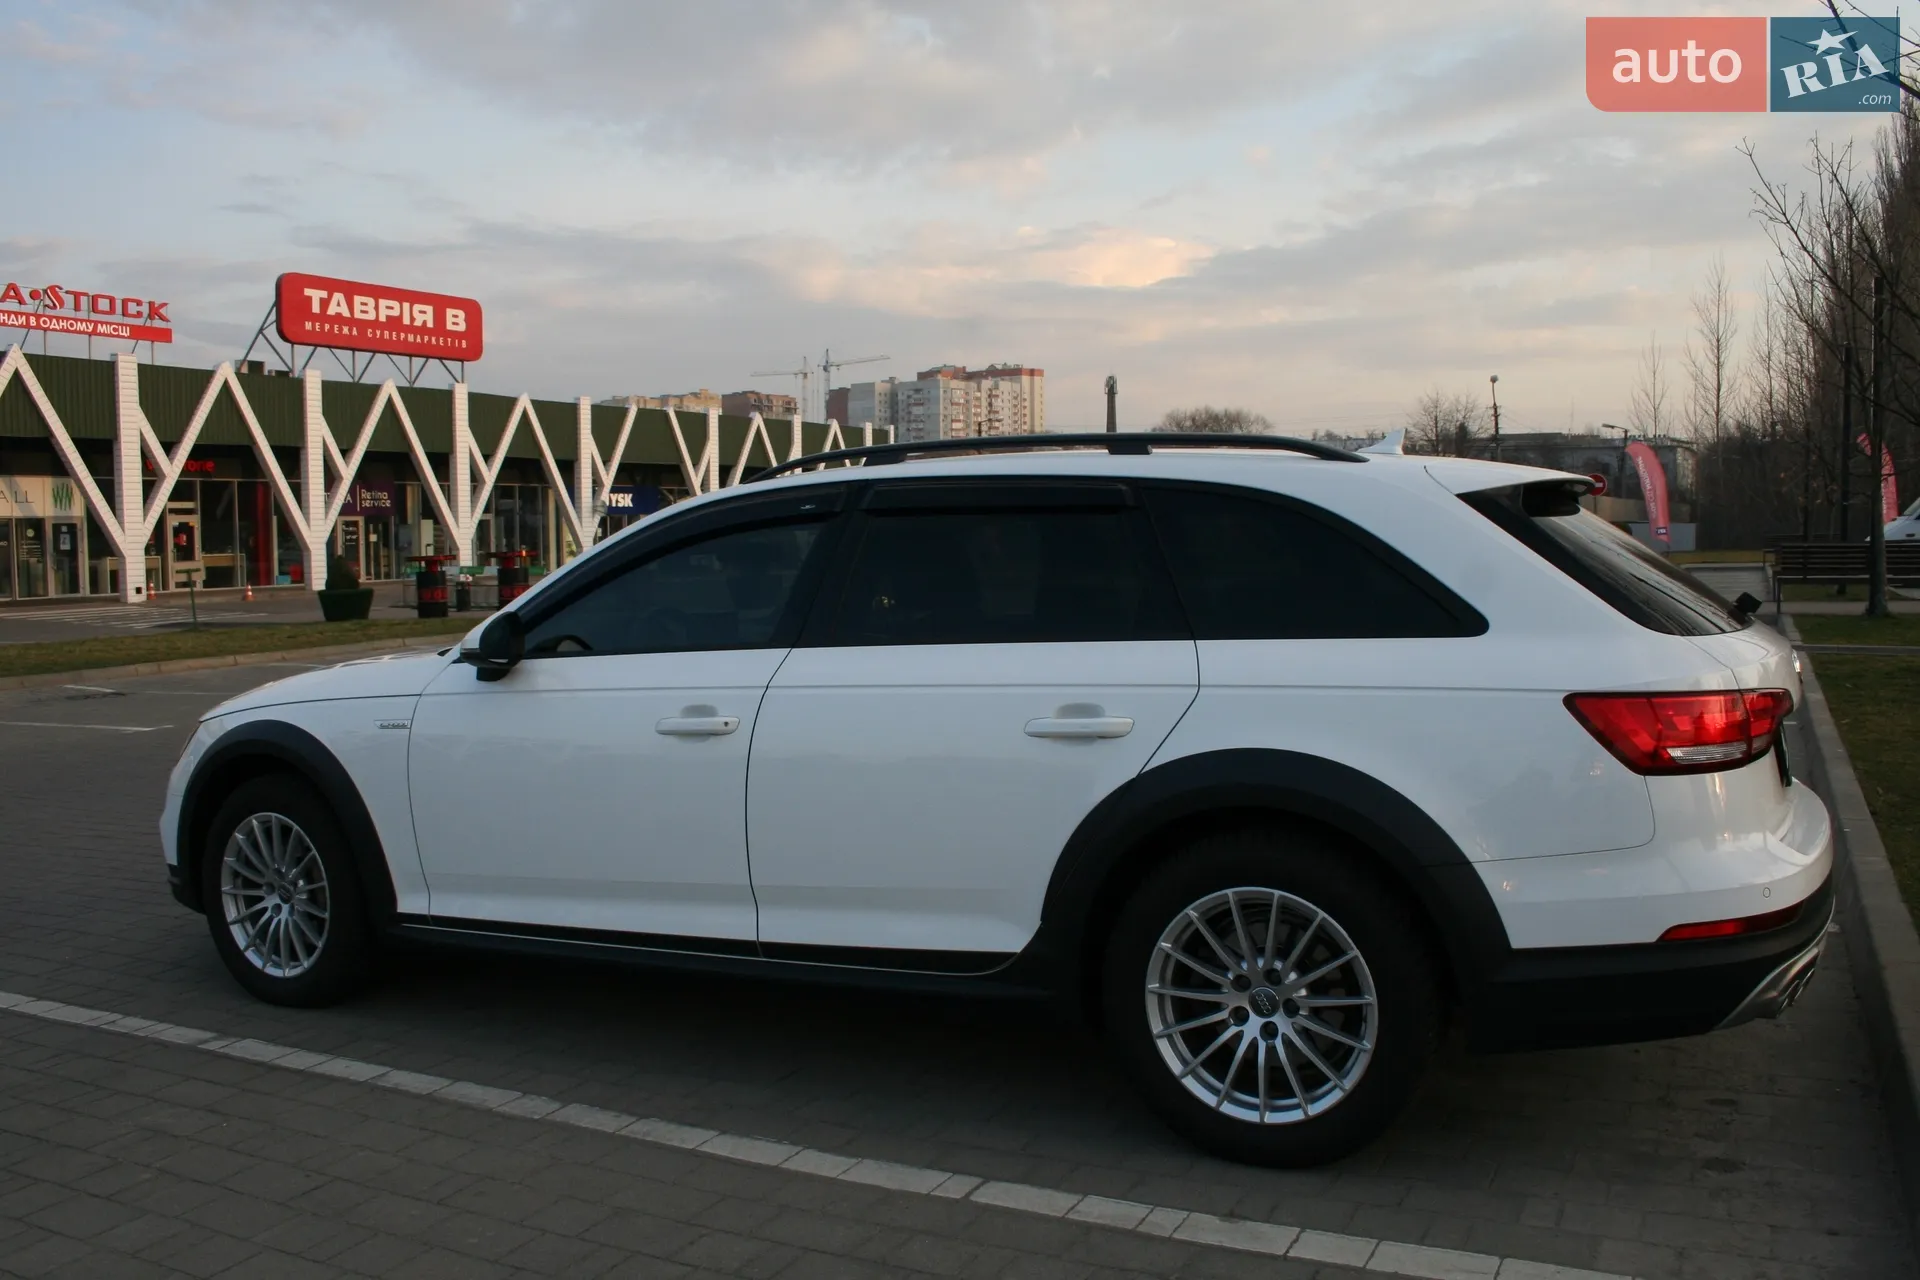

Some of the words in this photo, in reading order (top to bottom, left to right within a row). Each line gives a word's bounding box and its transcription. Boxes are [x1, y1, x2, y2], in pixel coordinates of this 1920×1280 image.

[303, 287, 434, 328] ТАВРІЯ
[446, 307, 467, 332] В
[29, 315, 37, 327] В
[40, 317, 94, 333] ОДНОМУ
[97, 323, 130, 337] МІСЦІ
[305, 321, 358, 336] МЕРЕЖА
[367, 328, 467, 348] СУПЕРМАРКЕТІВ
[361, 489, 389, 499] Retina
[361, 499, 391, 507] service
[607, 493, 634, 507] YSK
